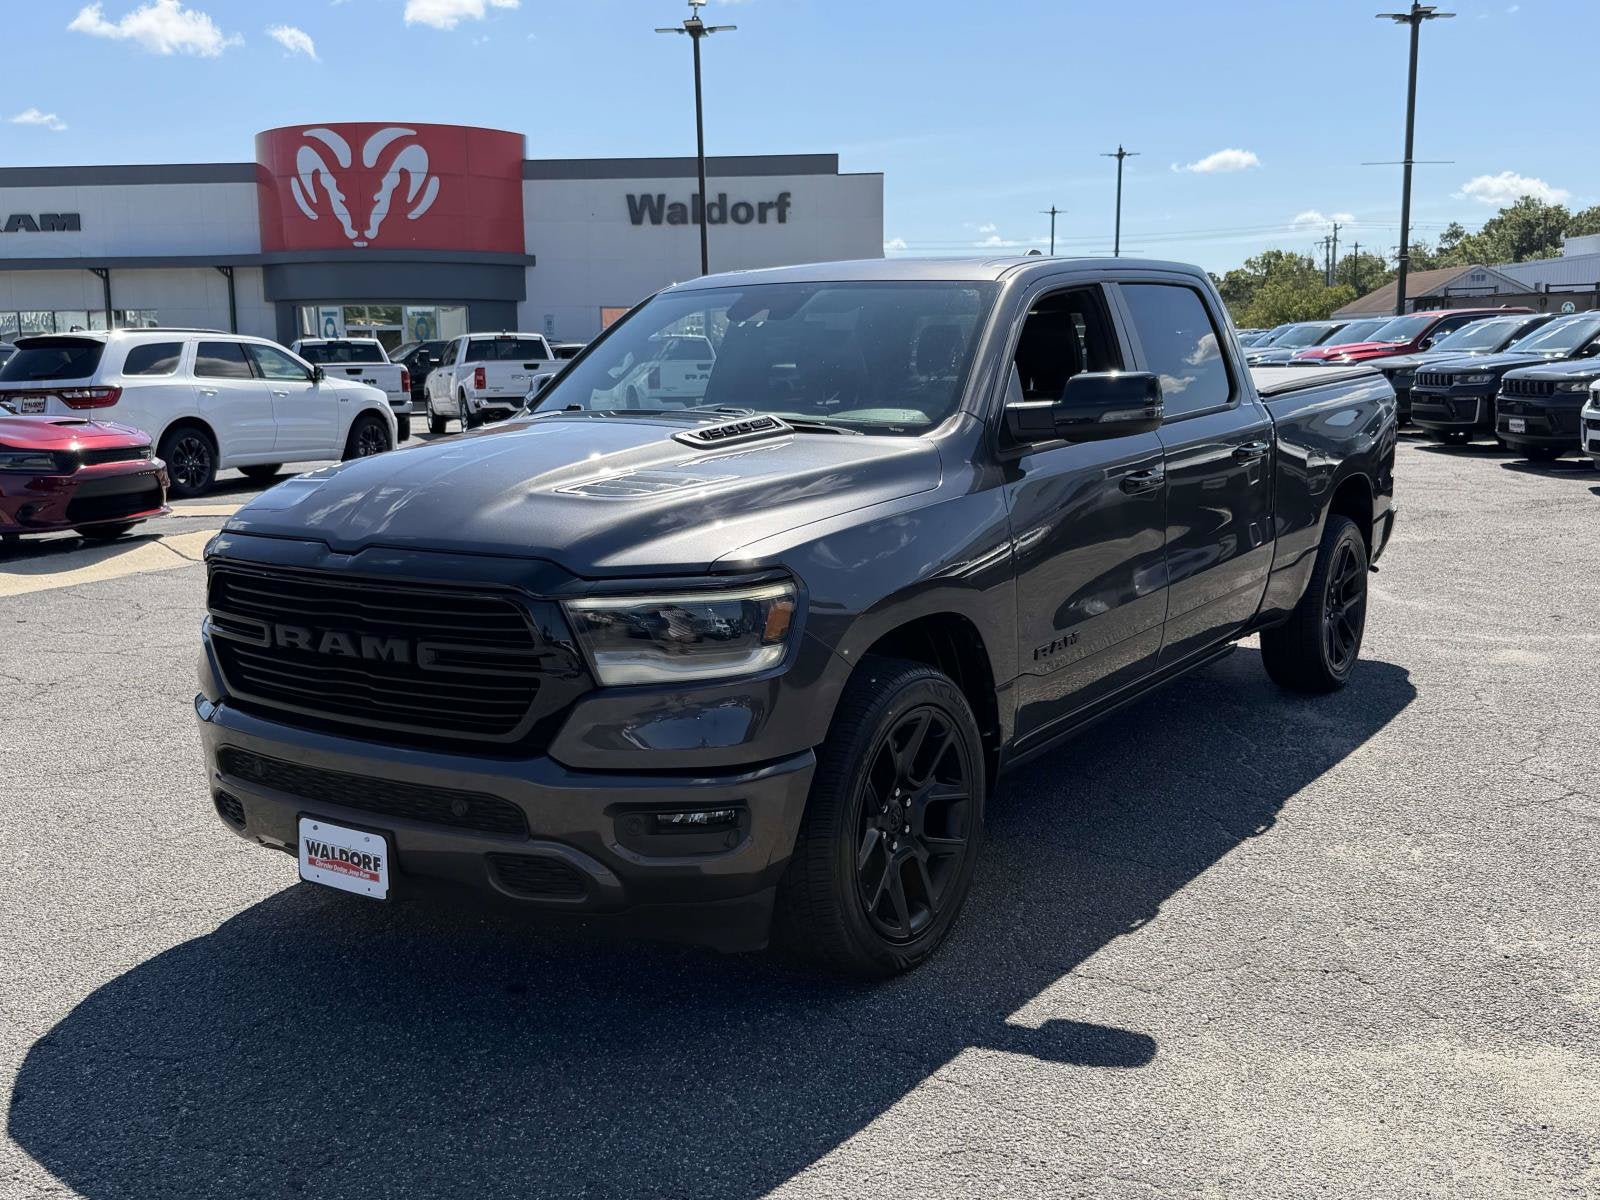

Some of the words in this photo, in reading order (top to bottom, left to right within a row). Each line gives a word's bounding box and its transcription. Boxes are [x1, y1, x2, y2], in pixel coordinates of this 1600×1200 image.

[0, 213, 81, 232] AM
[626, 191, 791, 225] Waldorf
[275, 623, 412, 664] RAM
[1033, 631, 1080, 661] RAM
[305, 839, 381, 872] WALDORF
